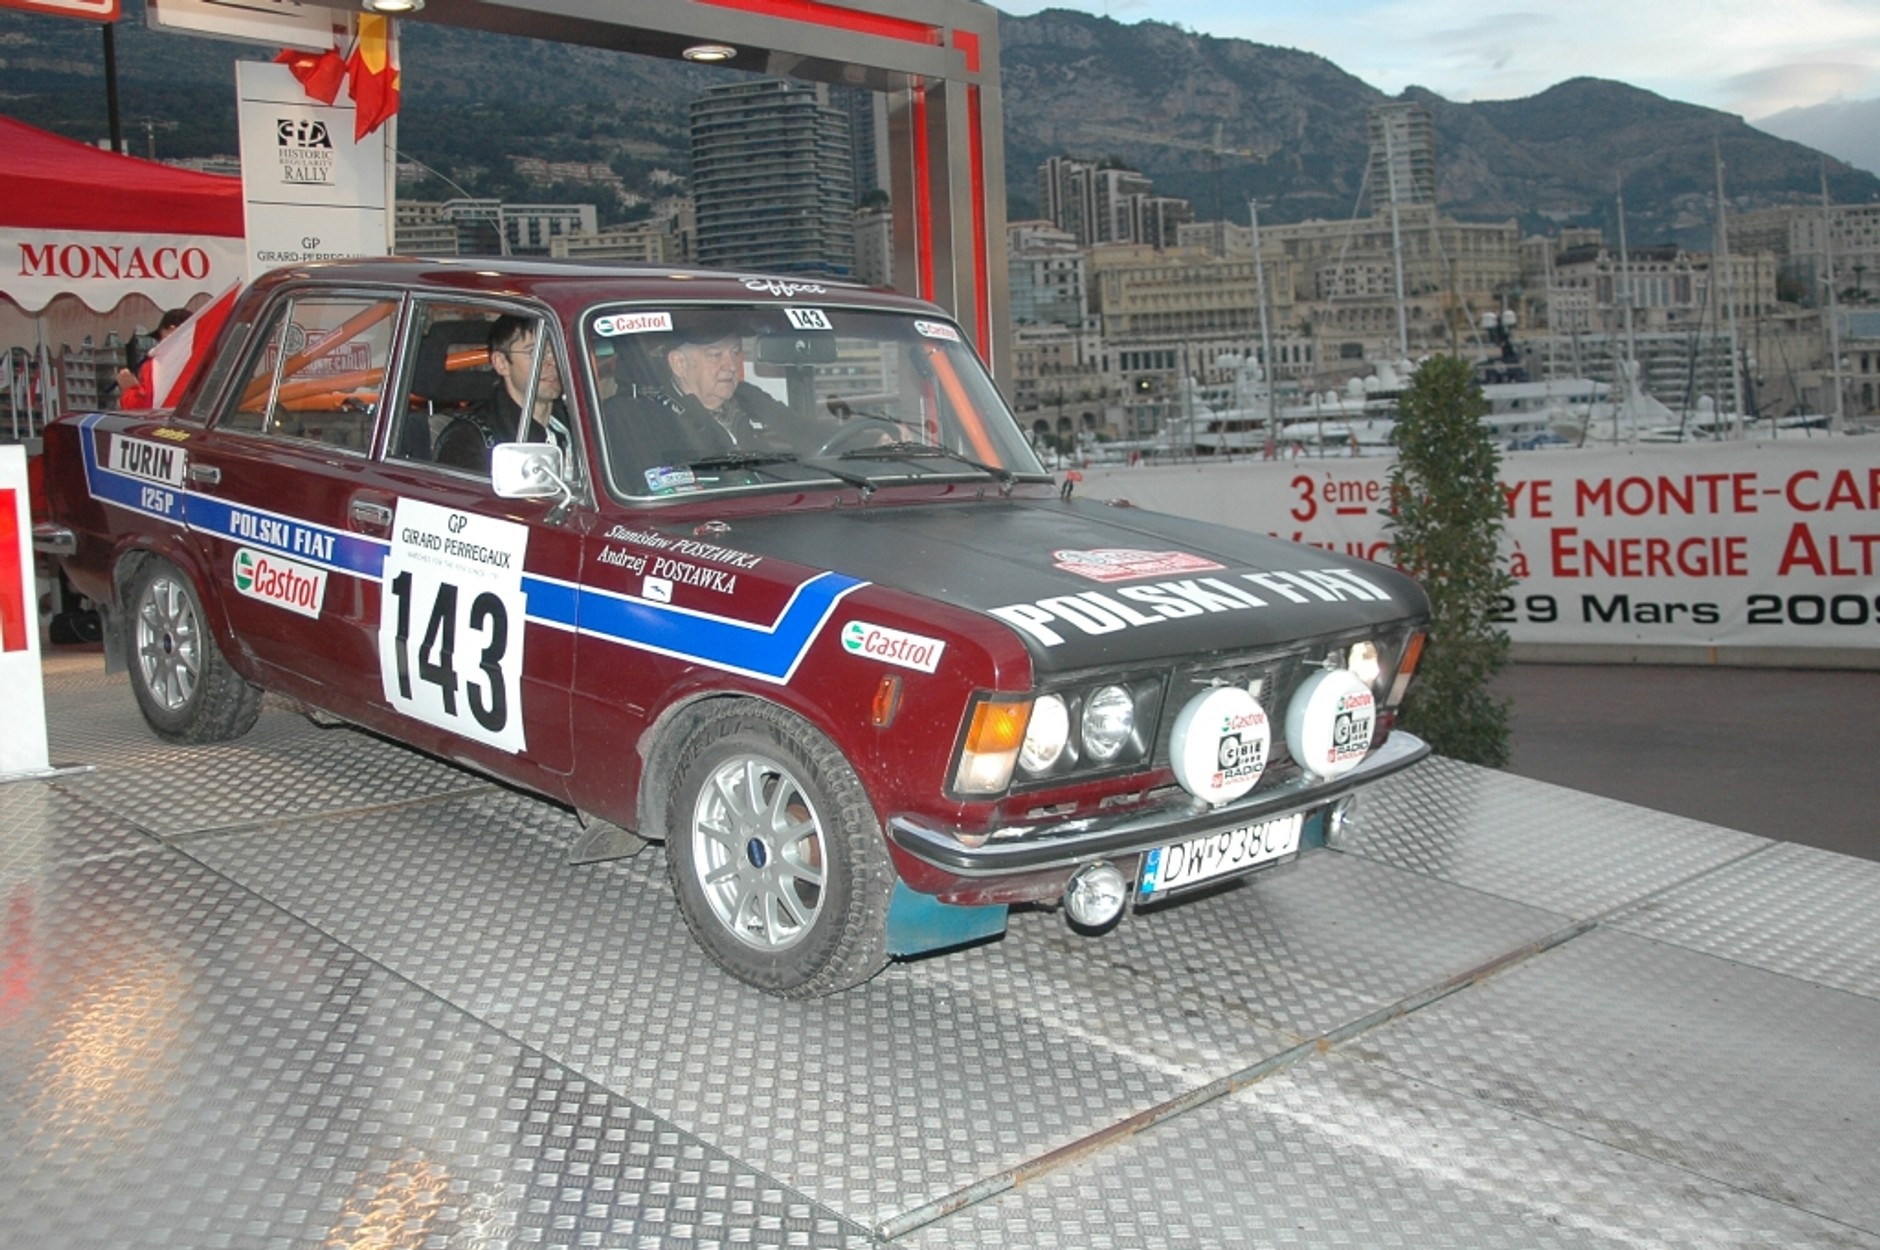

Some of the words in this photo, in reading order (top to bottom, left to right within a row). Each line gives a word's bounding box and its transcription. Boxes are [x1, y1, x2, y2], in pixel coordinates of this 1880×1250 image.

[279, 149, 333, 160] HISTORIC
[284, 165, 329, 182] RALLY
[301, 236, 321, 249] GP
[17, 242, 211, 280] MONACO
[616, 315, 668, 332] Castrol
[792, 310, 825, 328] 143
[119, 440, 174, 480] TURIN
[141, 486, 175, 514] 125P
[229, 510, 289, 548] POLSKI
[293, 528, 336, 561] FIAT
[448, 513, 467, 534] GP
[402, 527, 441, 551] GIRARD
[444, 538, 511, 569] PERREGAUX
[669, 539, 763, 569] POSTAWKA
[1510, 540, 1530, 578] à
[1551, 527, 1749, 578] ENERGIE
[254, 559, 320, 610] Castrol
[597, 545, 648, 576] Andrzej
[652, 556, 737, 595] POSTAWKA
[988, 577, 1269, 648] POLSKI
[1241, 568, 1392, 603] FIAT
[1582, 594, 1720, 624] Mars
[391, 570, 508, 733] 143
[864, 630, 936, 667] Castrol
[1231, 713, 1264, 730] Castrol
[1225, 763, 1263, 779] RADIO
[1164, 837, 1207, 882] DW
